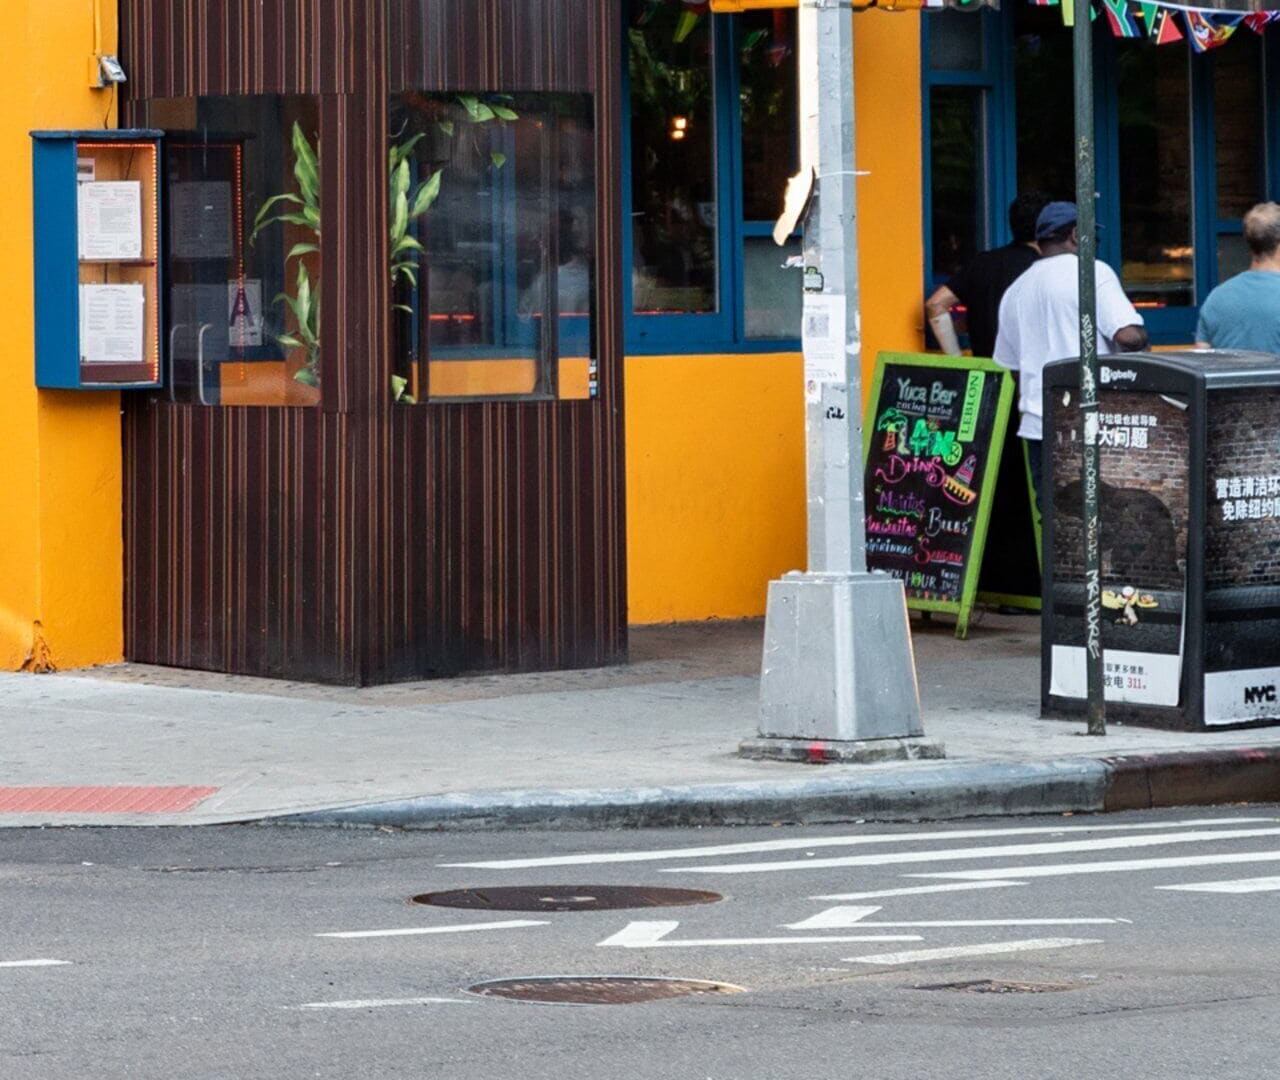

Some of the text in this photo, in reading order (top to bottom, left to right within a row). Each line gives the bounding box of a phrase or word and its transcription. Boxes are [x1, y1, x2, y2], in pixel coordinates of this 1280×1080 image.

[961, 375, 979, 435] LEBLON
[1098, 425, 1149, 448] 大问题
[1244, 685, 1276, 705] NYC
